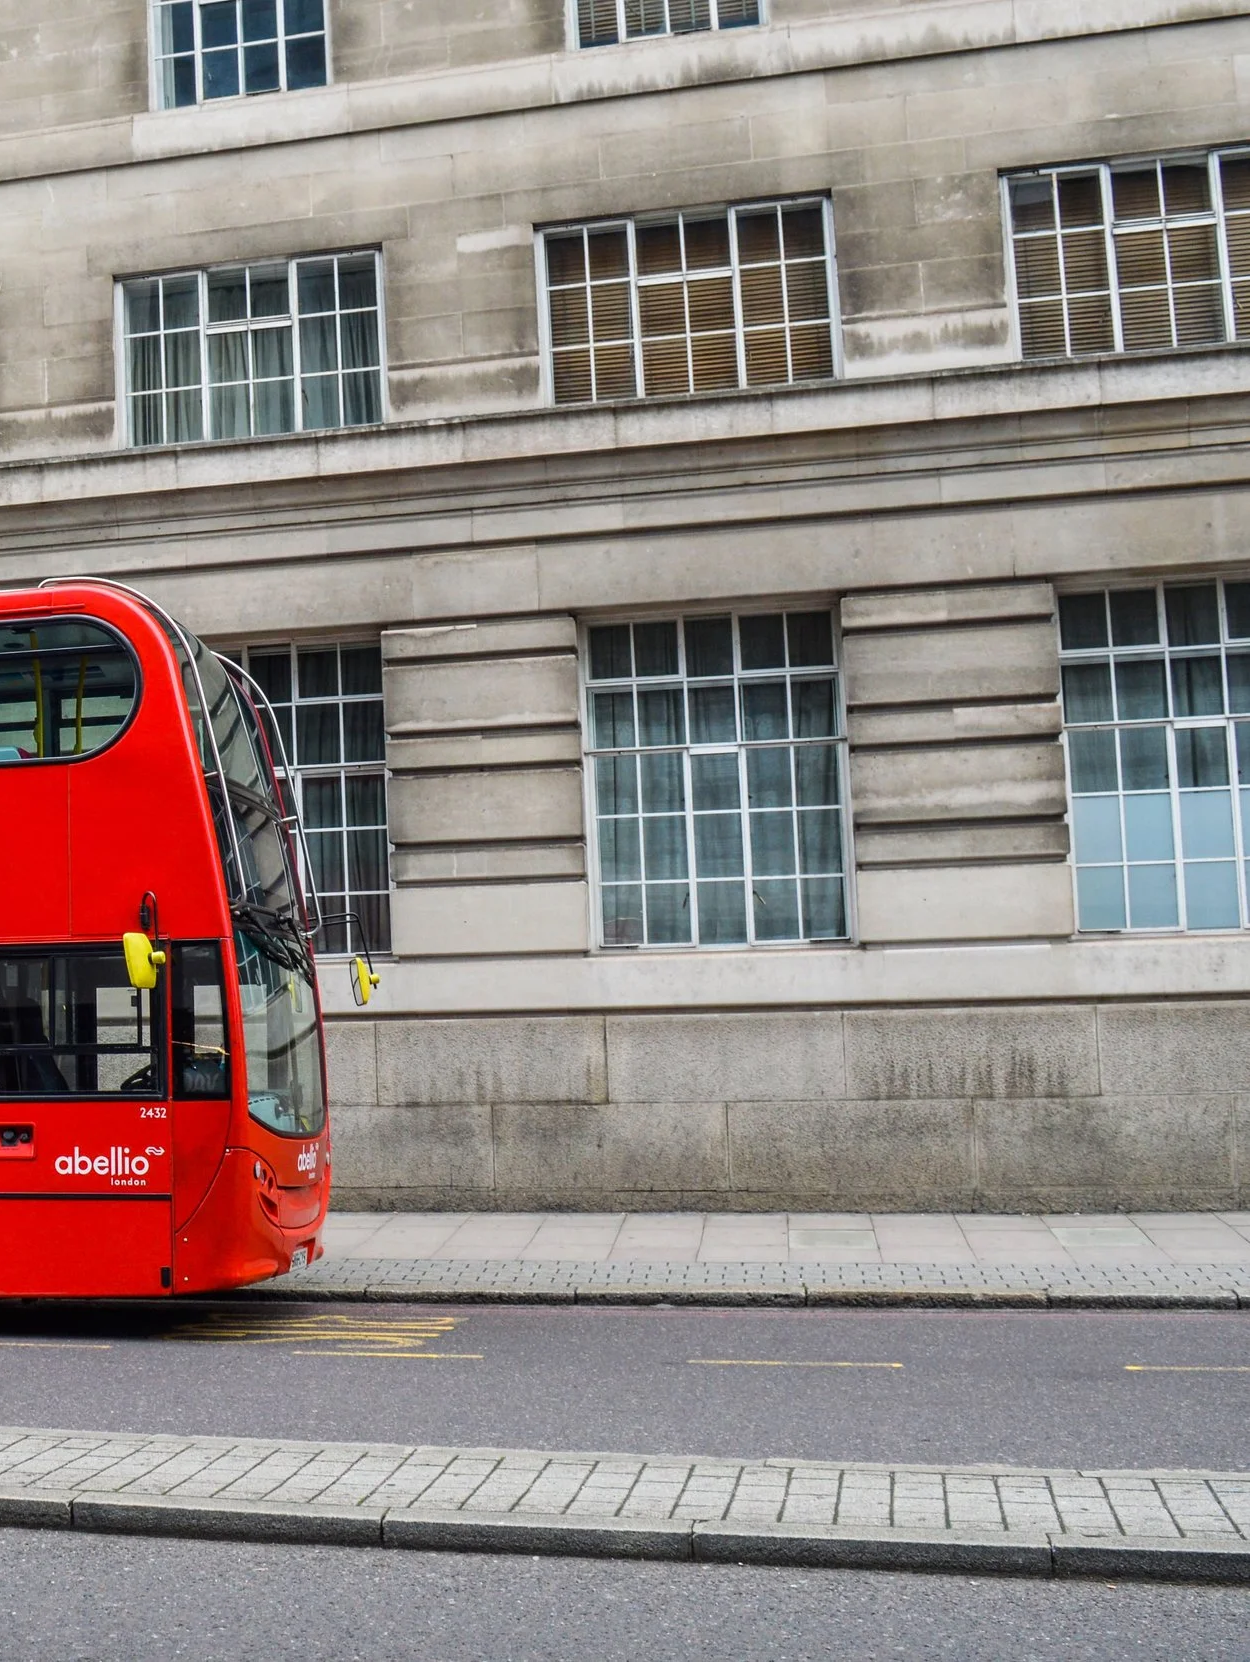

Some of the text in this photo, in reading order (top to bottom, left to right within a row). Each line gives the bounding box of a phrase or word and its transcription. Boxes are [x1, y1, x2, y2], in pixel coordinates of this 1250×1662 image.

[139, 1106, 167, 1119] 2432
[54, 1146, 150, 1176] abellio
[110, 1177, 147, 1186] london
